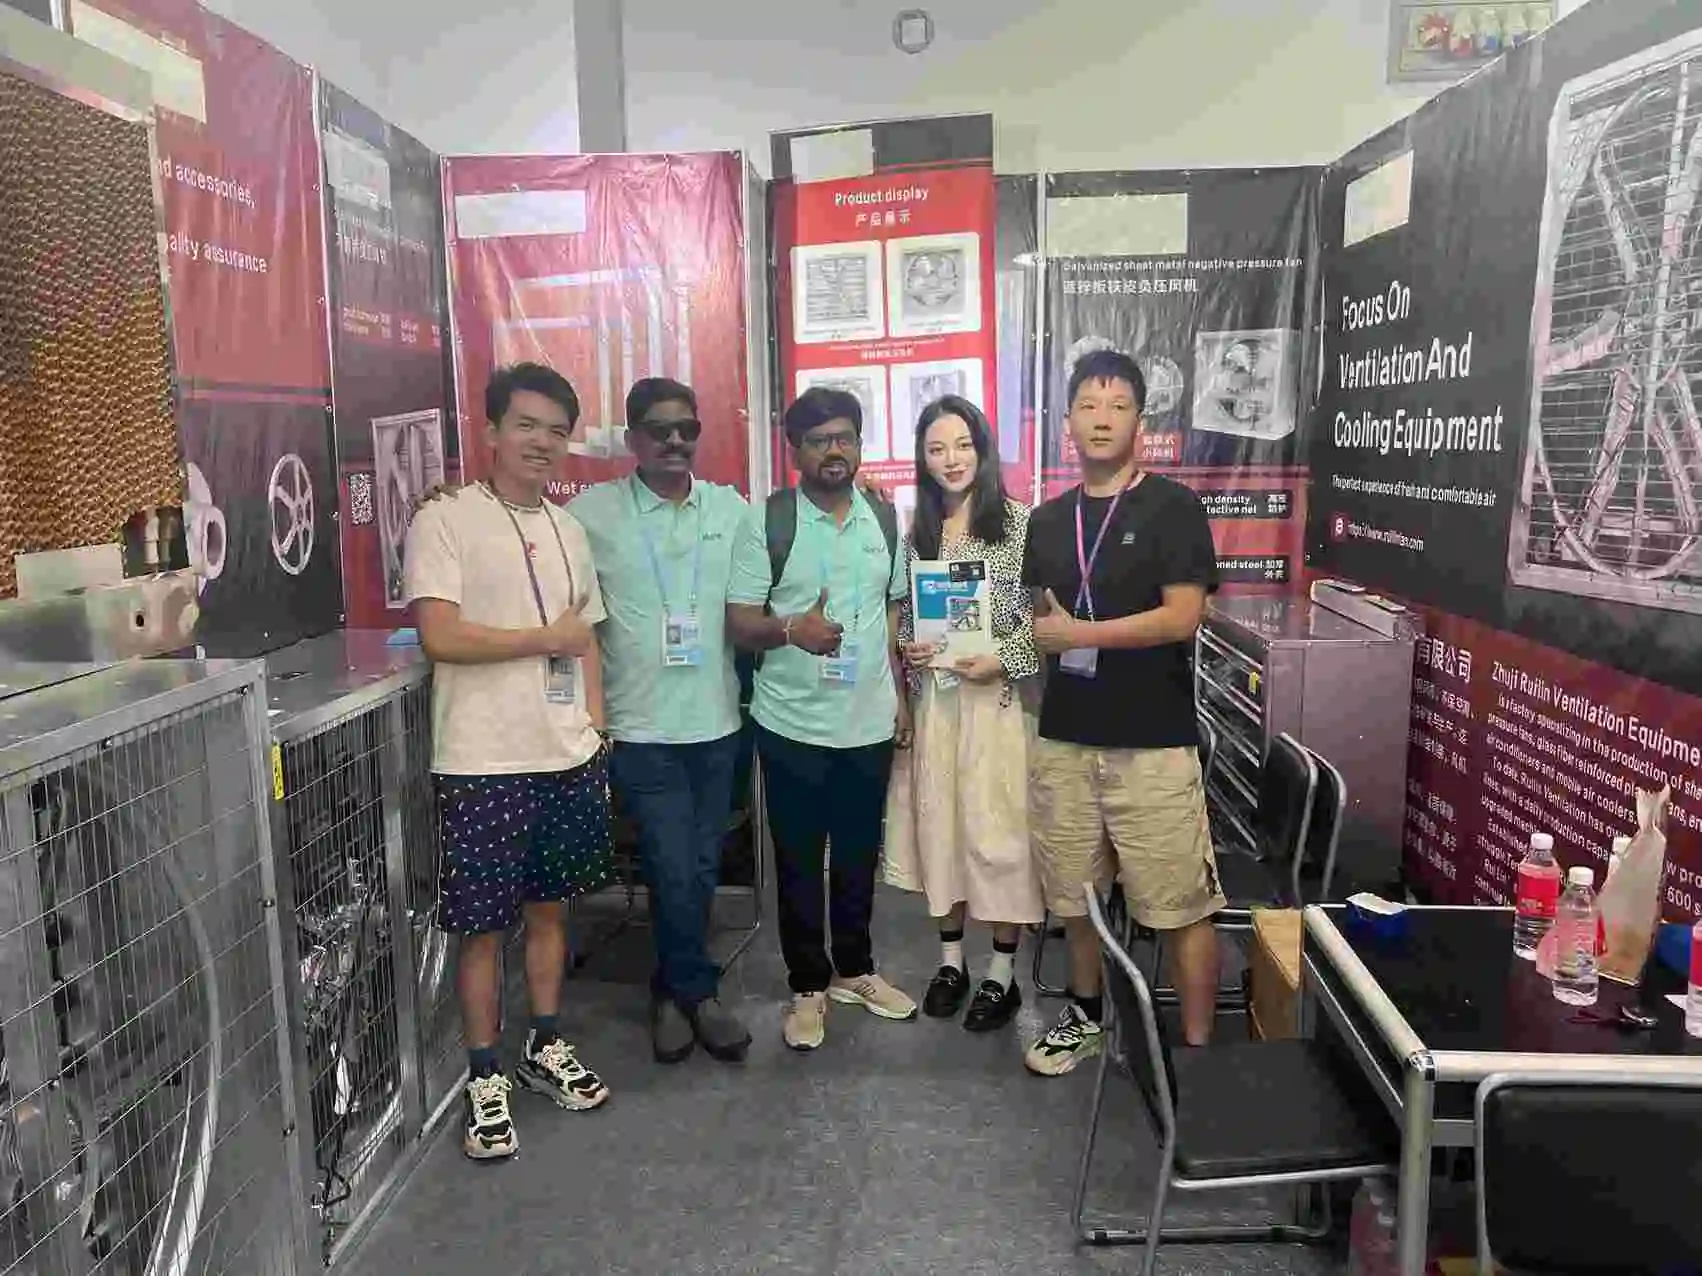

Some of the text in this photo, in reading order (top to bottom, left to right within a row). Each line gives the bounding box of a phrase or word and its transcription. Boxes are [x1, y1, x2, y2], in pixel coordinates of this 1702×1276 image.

[834, 185, 929, 207] Product display
[204, 242, 268, 273] assurance
[1237, 258, 1283, 272] pressure
[1342, 280, 1411, 331] Focus On
[1340, 331, 1473, 389] Ventilation And
[1334, 405, 1504, 457] Cooling Equipment
[1214, 495, 1251, 505] density
[1431, 485, 1482, 506] comfortable
[1483, 489, 1497, 507] air
[1492, 660, 1519, 691] Zhuji
[1553, 684, 1625, 736] Ventilation
[1510, 697, 1536, 724] factory
[1582, 733, 1592, 750] in
[1592, 736, 1610, 759] the
[1611, 748, 1668, 784] production
[1670, 774, 1683, 790] of
[1575, 756, 1625, 793] reinforced
[1582, 785, 1597, 802] air
